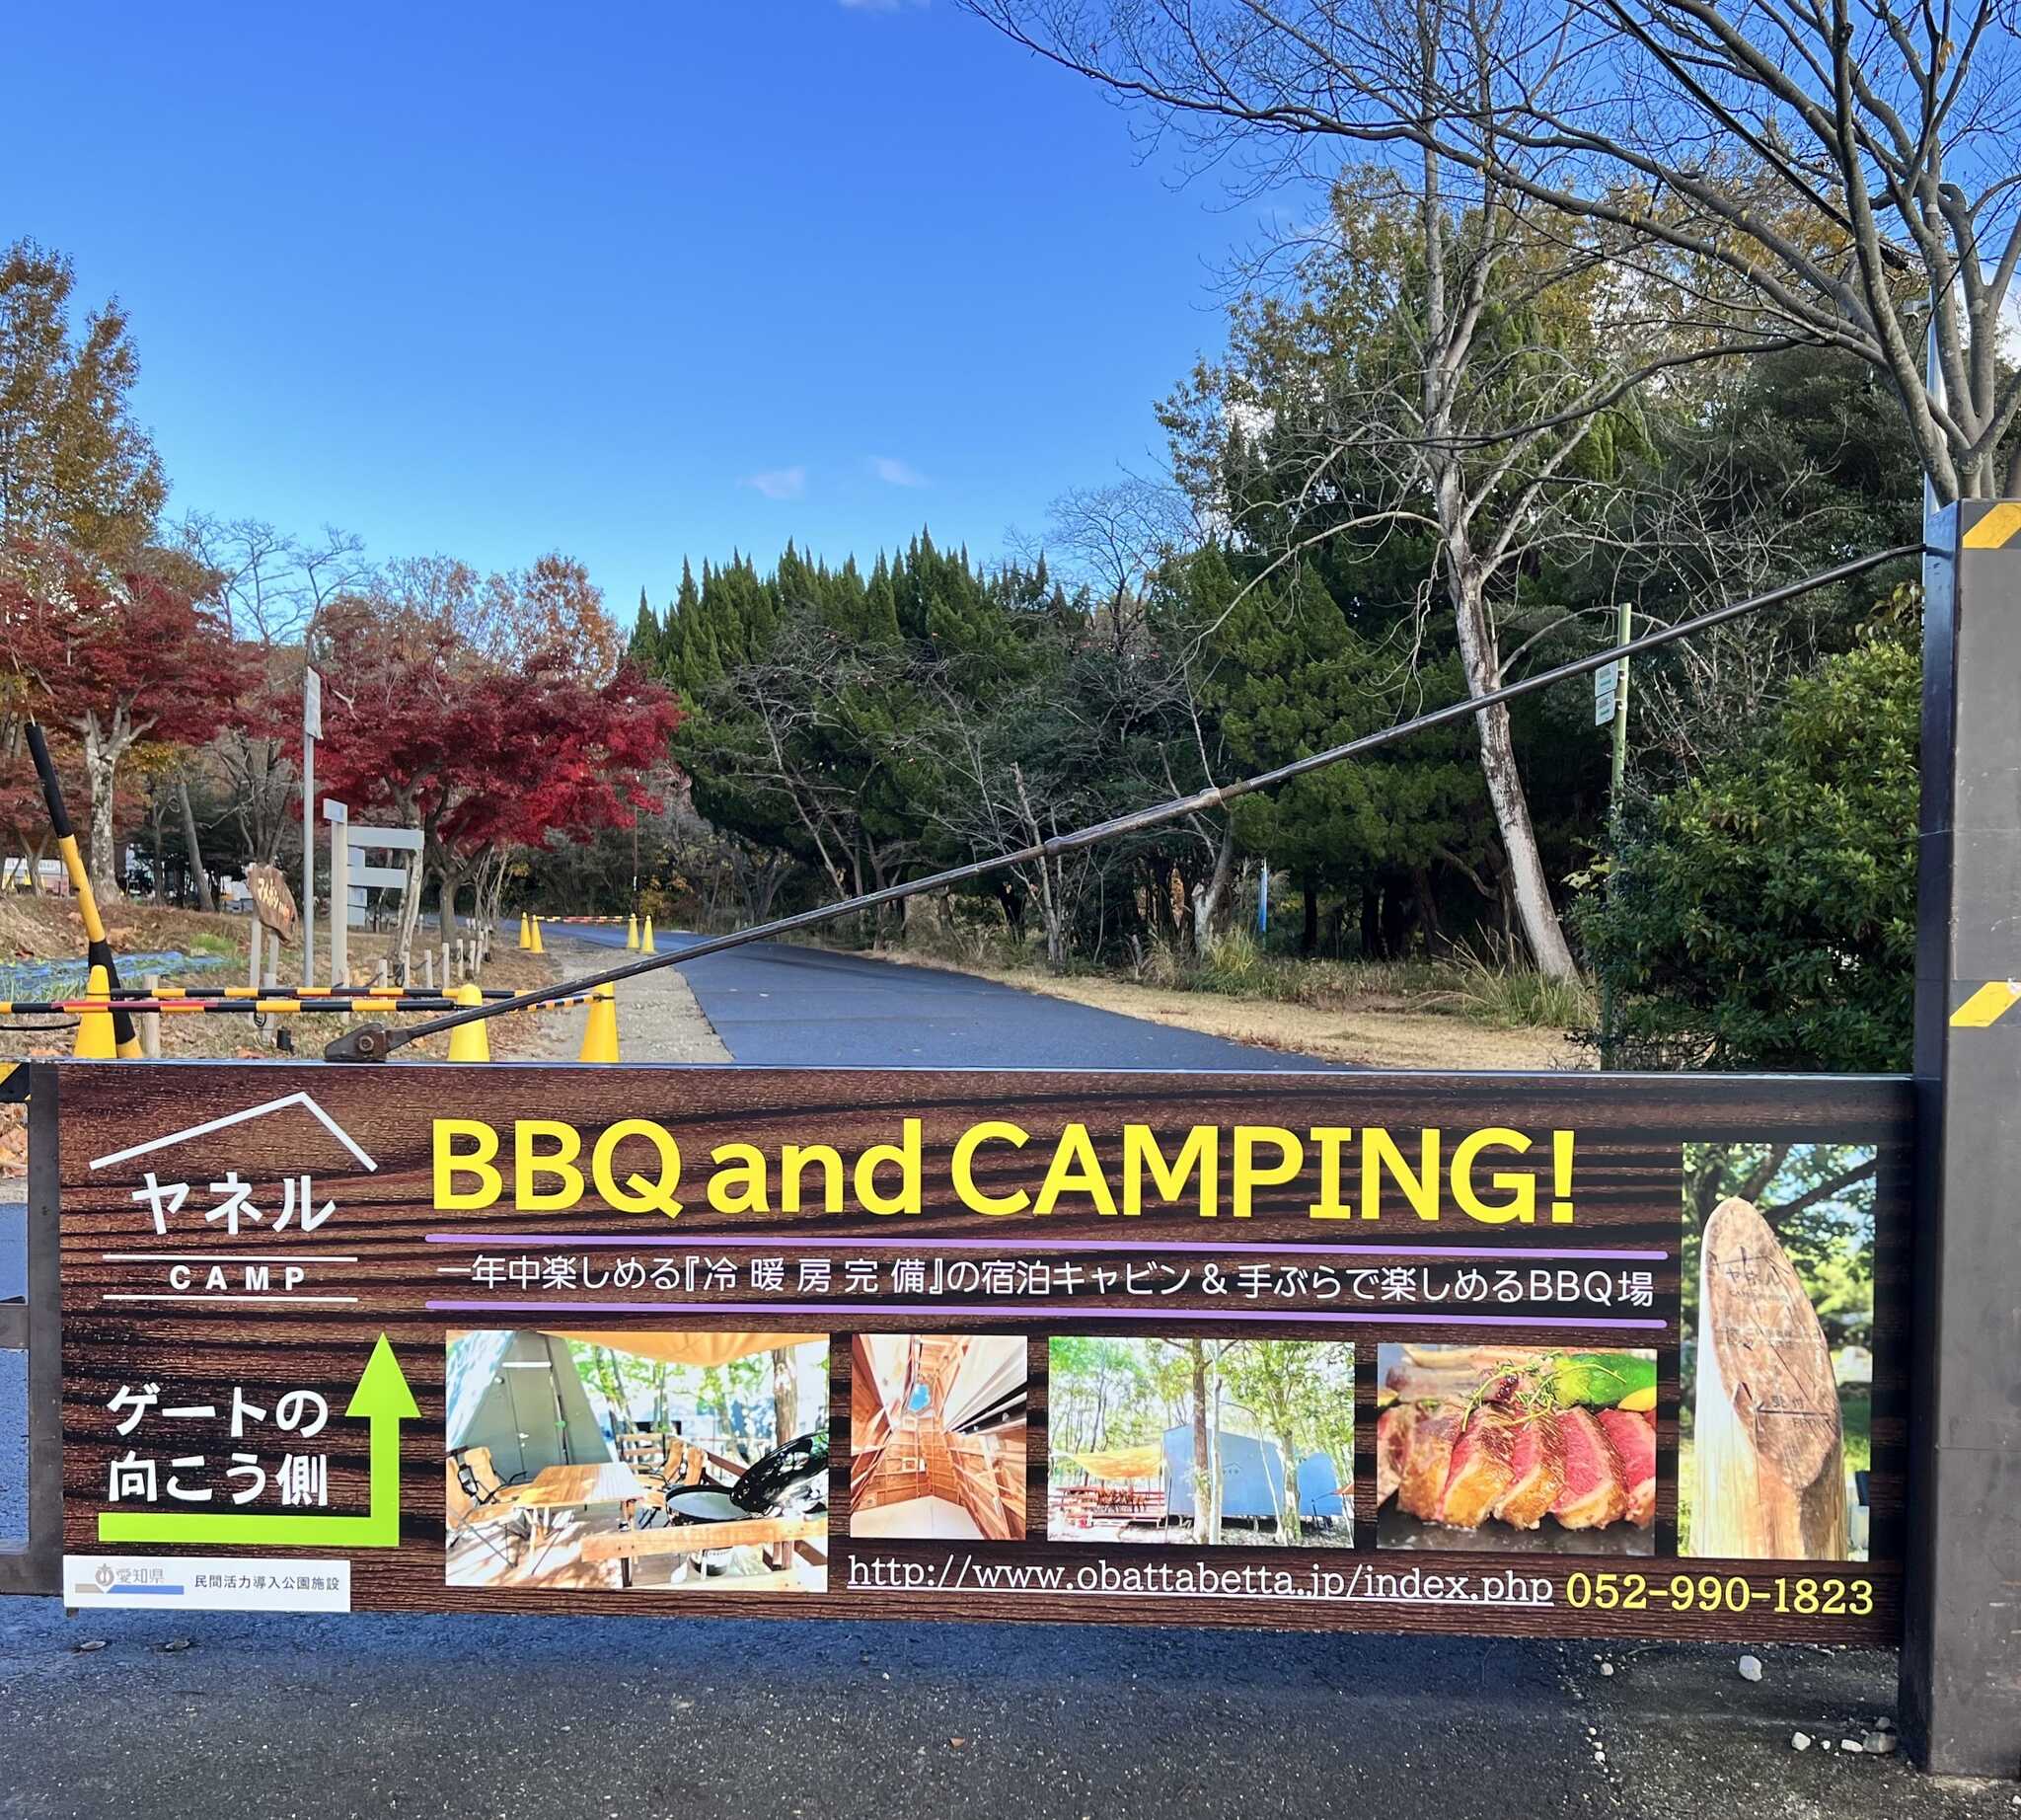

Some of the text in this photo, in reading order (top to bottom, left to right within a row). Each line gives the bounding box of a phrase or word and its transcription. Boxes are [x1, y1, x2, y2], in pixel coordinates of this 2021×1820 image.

[432, 1117, 1575, 1224] BBQ and CAMPING!
[131, 1172, 337, 1236] ヤネル
[169, 1264, 305, 1291] CAMP
[107, 1382, 329, 1438] ゲートの
[109, 1450, 328, 1506] 向こう側
[115, 1568, 340, 1592] 愛知県 民間活力導入公園施設
[1566, 1571, 1874, 1616] 052-990-1823
